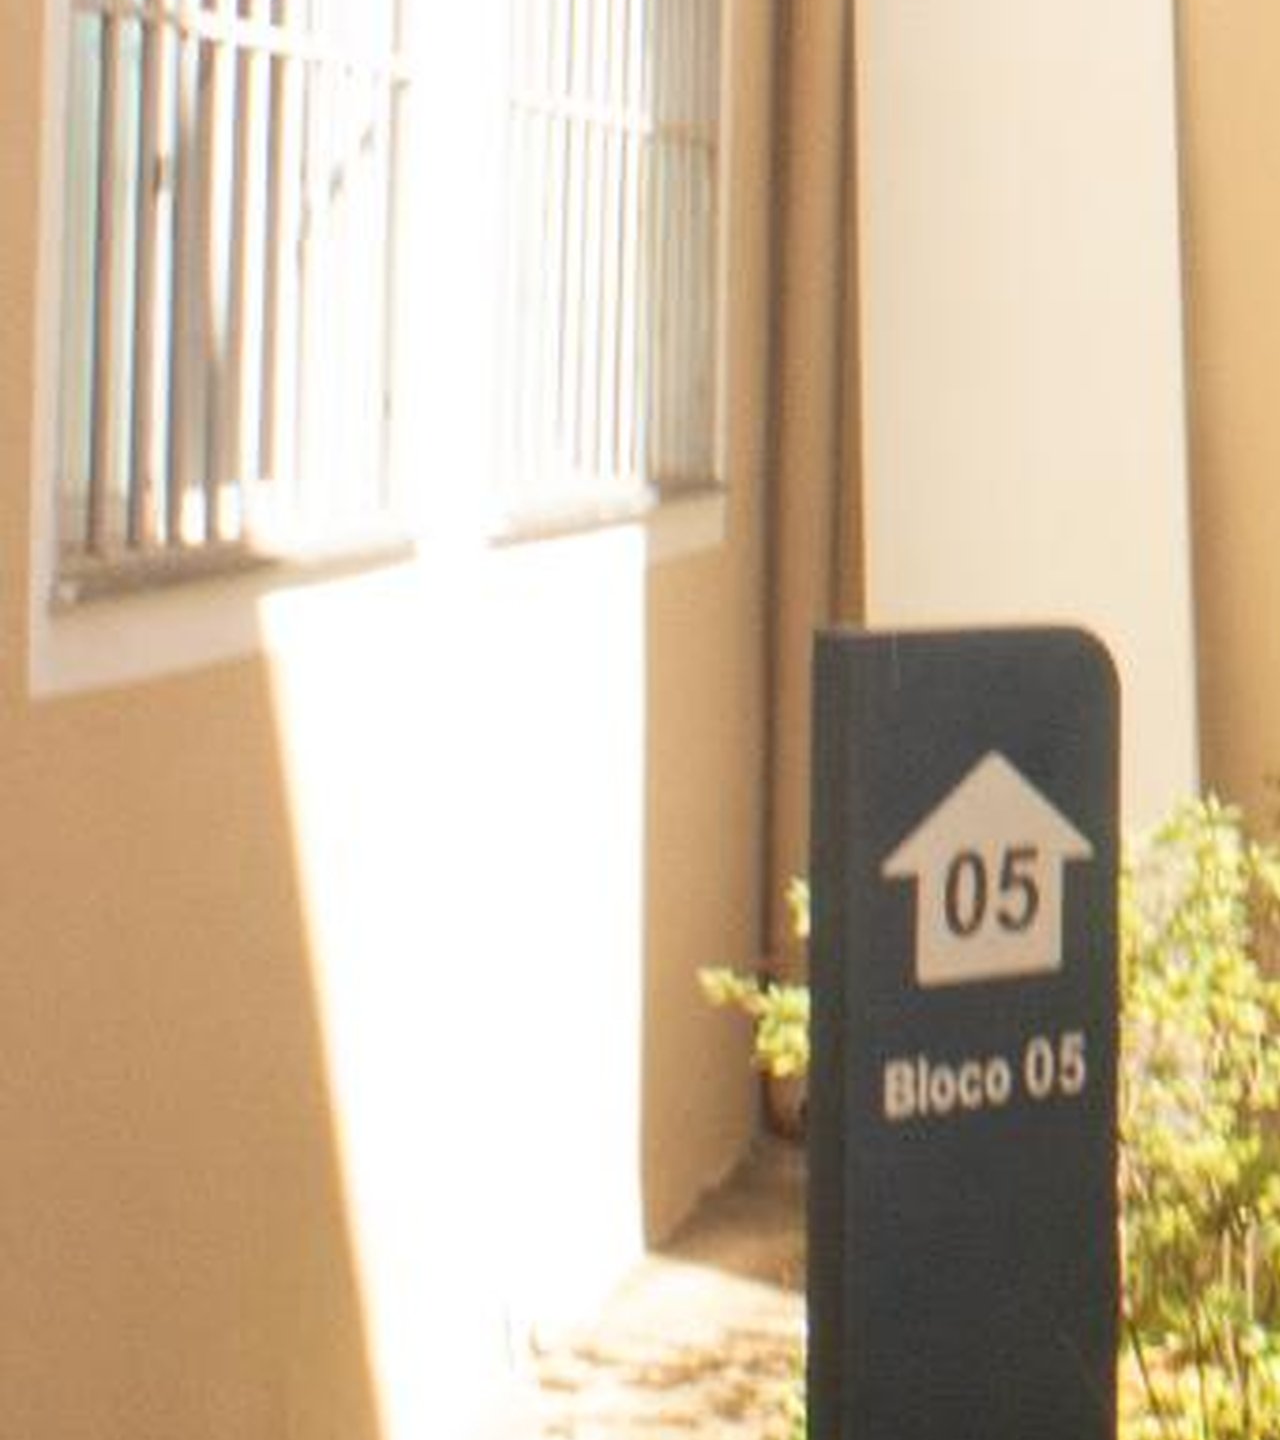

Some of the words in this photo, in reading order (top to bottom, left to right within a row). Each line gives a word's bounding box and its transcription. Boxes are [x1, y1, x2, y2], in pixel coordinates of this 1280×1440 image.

[943, 848, 1040, 938] 05
[882, 1053, 1012, 1120] Bloco
[1024, 1031, 1088, 1099] 05
